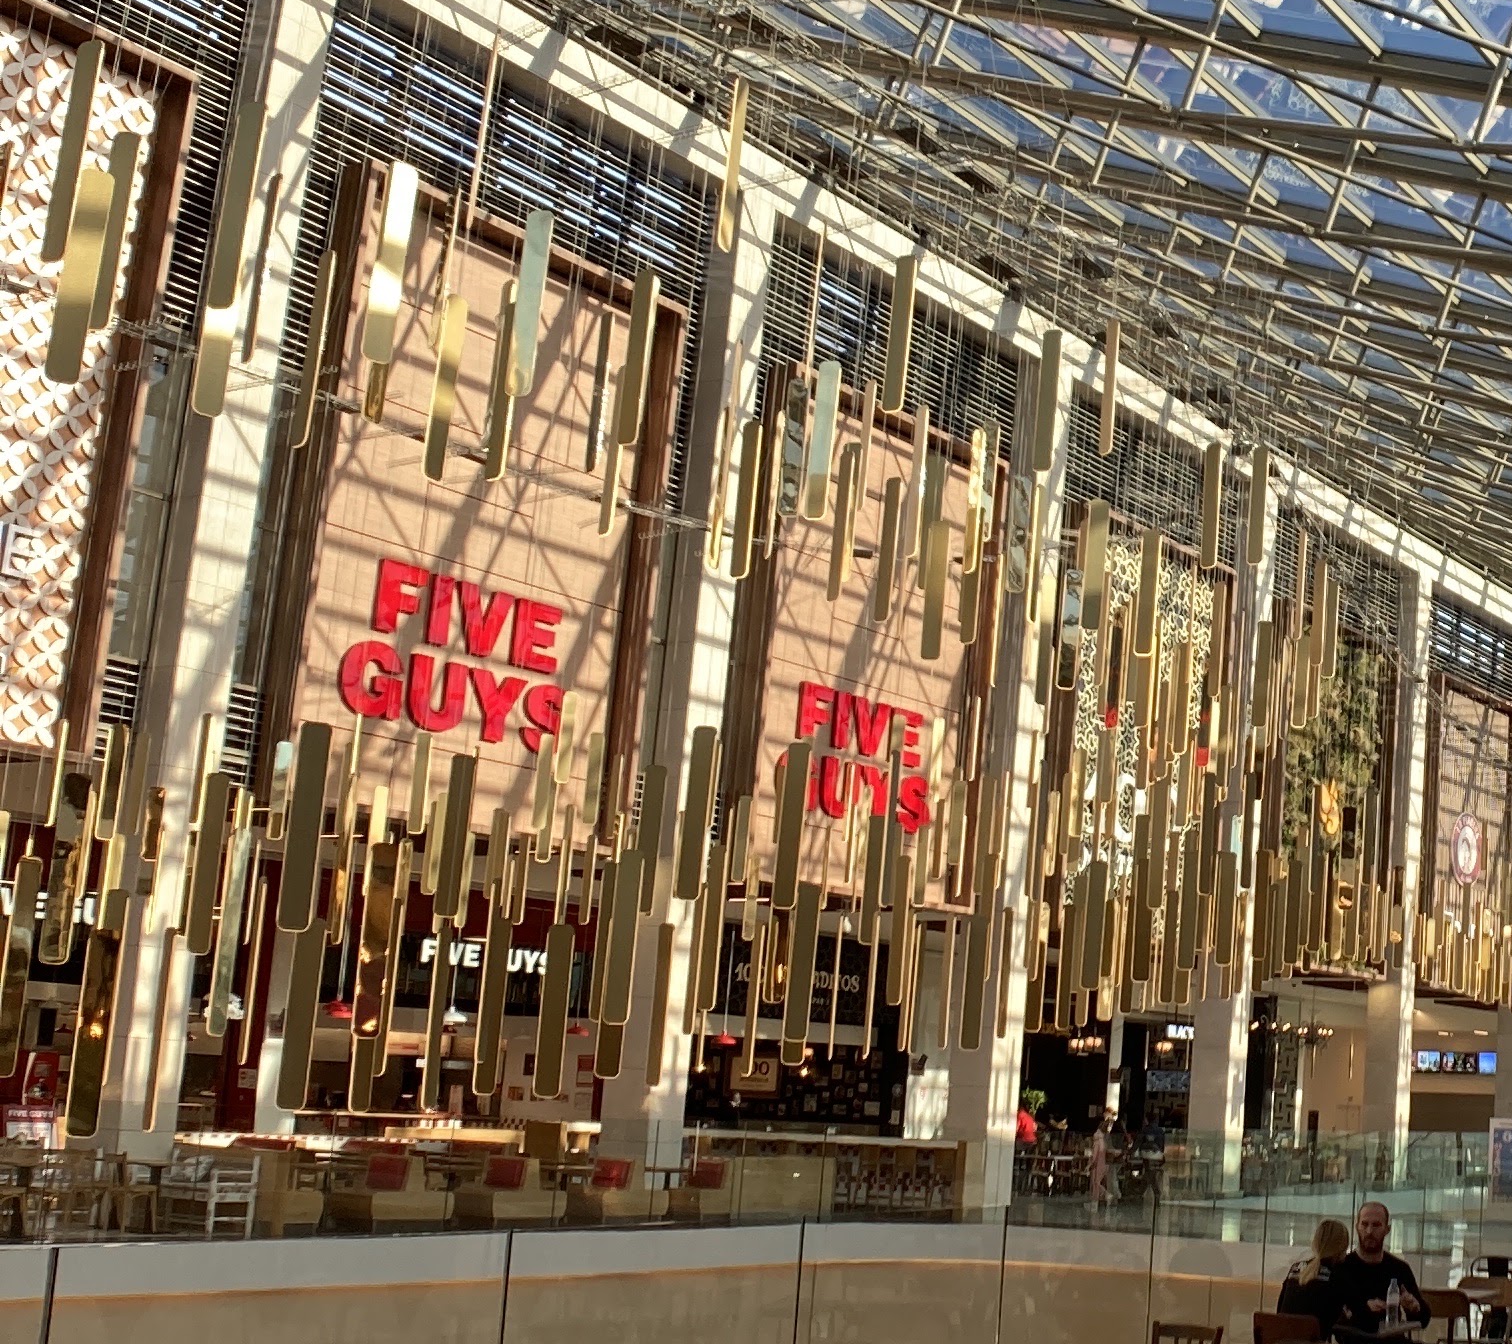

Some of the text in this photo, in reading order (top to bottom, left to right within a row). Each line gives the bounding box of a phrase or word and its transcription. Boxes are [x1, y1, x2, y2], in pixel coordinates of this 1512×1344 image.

[371, 558, 563, 675] FIVE
[337, 640, 566, 755] GUYS
[795, 681, 923, 768] FIVE
[775, 750, 930, 834] UYS
[420, 938, 547, 975] FVE UYS
